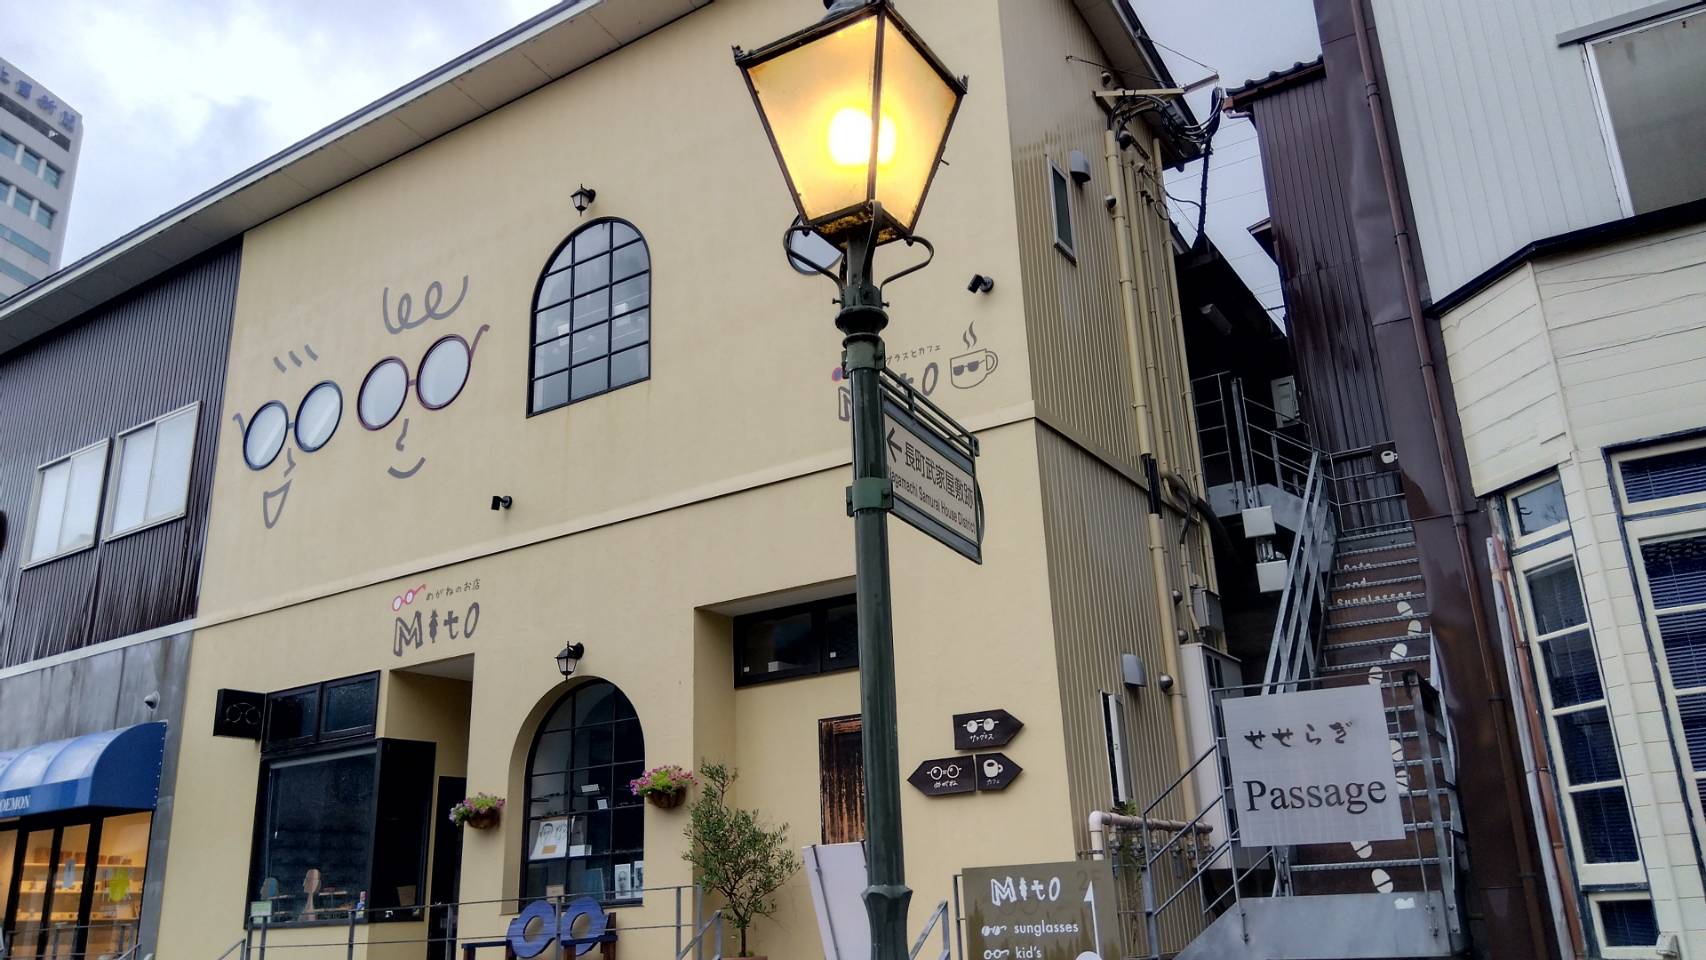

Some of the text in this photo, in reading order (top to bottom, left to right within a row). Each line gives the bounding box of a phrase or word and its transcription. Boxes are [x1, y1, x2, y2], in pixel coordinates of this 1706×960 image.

[905, 442, 973, 509] 長町武家屋敷跡
[918, 486, 940, 511] Samurai
[941, 502, 957, 523] House
[958, 512, 975, 535] District
[1244, 721, 1353, 749] せせらぎ
[1243, 780, 1387, 814] Passage
[1014, 920, 1079, 936] sunglasses
[1015, 945, 1043, 959] kid's
